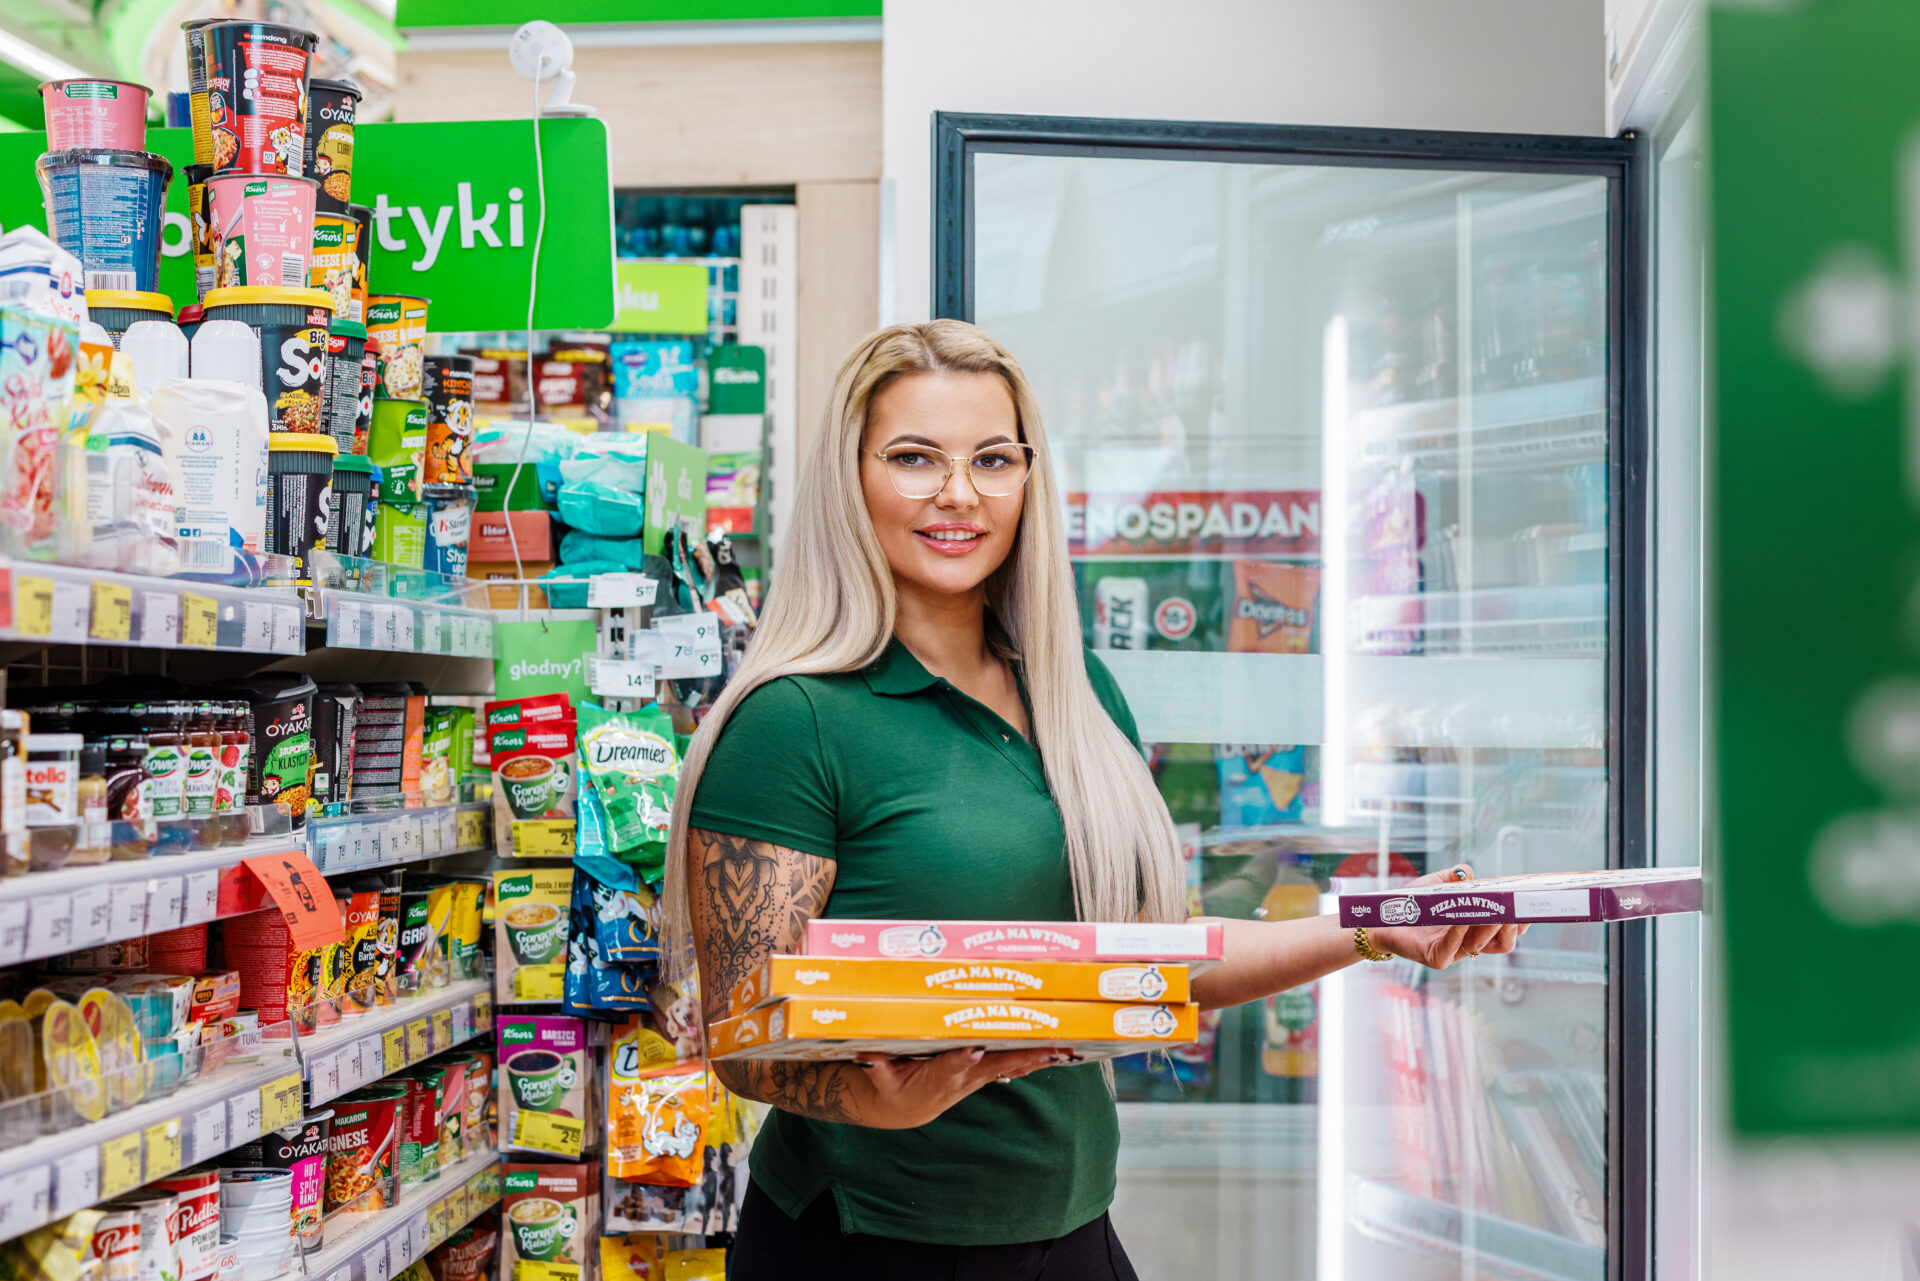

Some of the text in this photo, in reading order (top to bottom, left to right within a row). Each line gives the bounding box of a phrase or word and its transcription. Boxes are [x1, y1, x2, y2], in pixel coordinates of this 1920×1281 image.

[320, 107, 354, 123] OYAKA
[313, 254, 341, 268] HEESE
[367, 308, 400, 320] Knorr
[309, 331, 326, 349] Big
[1066, 502, 1319, 539] ENOSPADAN
[636, 587, 644, 598] 5
[1238, 599, 1306, 626] Doritos
[697, 627, 706, 639] 9
[675, 646, 683, 658] 7
[701, 655, 709, 666] 9
[510, 658, 582, 682] głodny?
[628, 675, 642, 686] 14
[494, 736, 524, 747] Knorr
[597, 741, 667, 764] Dreamies
[27, 768, 67, 784] tella
[561, 832, 569, 845] 2
[500, 883, 531, 893] Knorr
[1430, 897, 1506, 916] PIZZA NA WYNOS
[1619, 897, 1642, 909] żabka
[1351, 905, 1372, 917] żabka
[831, 932, 866, 948] żabka
[963, 929, 1005, 950] PIZZA
[1007, 928, 1028, 940] NA
[1029, 928, 1081, 950] WYNOS
[795, 970, 830, 985] żabka
[925, 966, 1043, 990] PIZZA NA WYNOS
[953, 982, 1016, 992] MARGHERITA
[812, 1009, 847, 1024] żabka
[943, 1006, 1060, 1029] PIZZA NA WYNOS
[972, 1022, 1032, 1031] MARGHERITA
[504, 1029, 576, 1041] Knorr BARSZCZ
[335, 1111, 368, 1127] MAKARON
[328, 1128, 370, 1153] GNESE
[561, 1131, 569, 1144] 2
[304, 1162, 317, 1177] HOT
[300, 1180, 319, 1195] SPICY
[506, 1177, 535, 1188] Knorr
[179, 1201, 219, 1232] Pudlis
